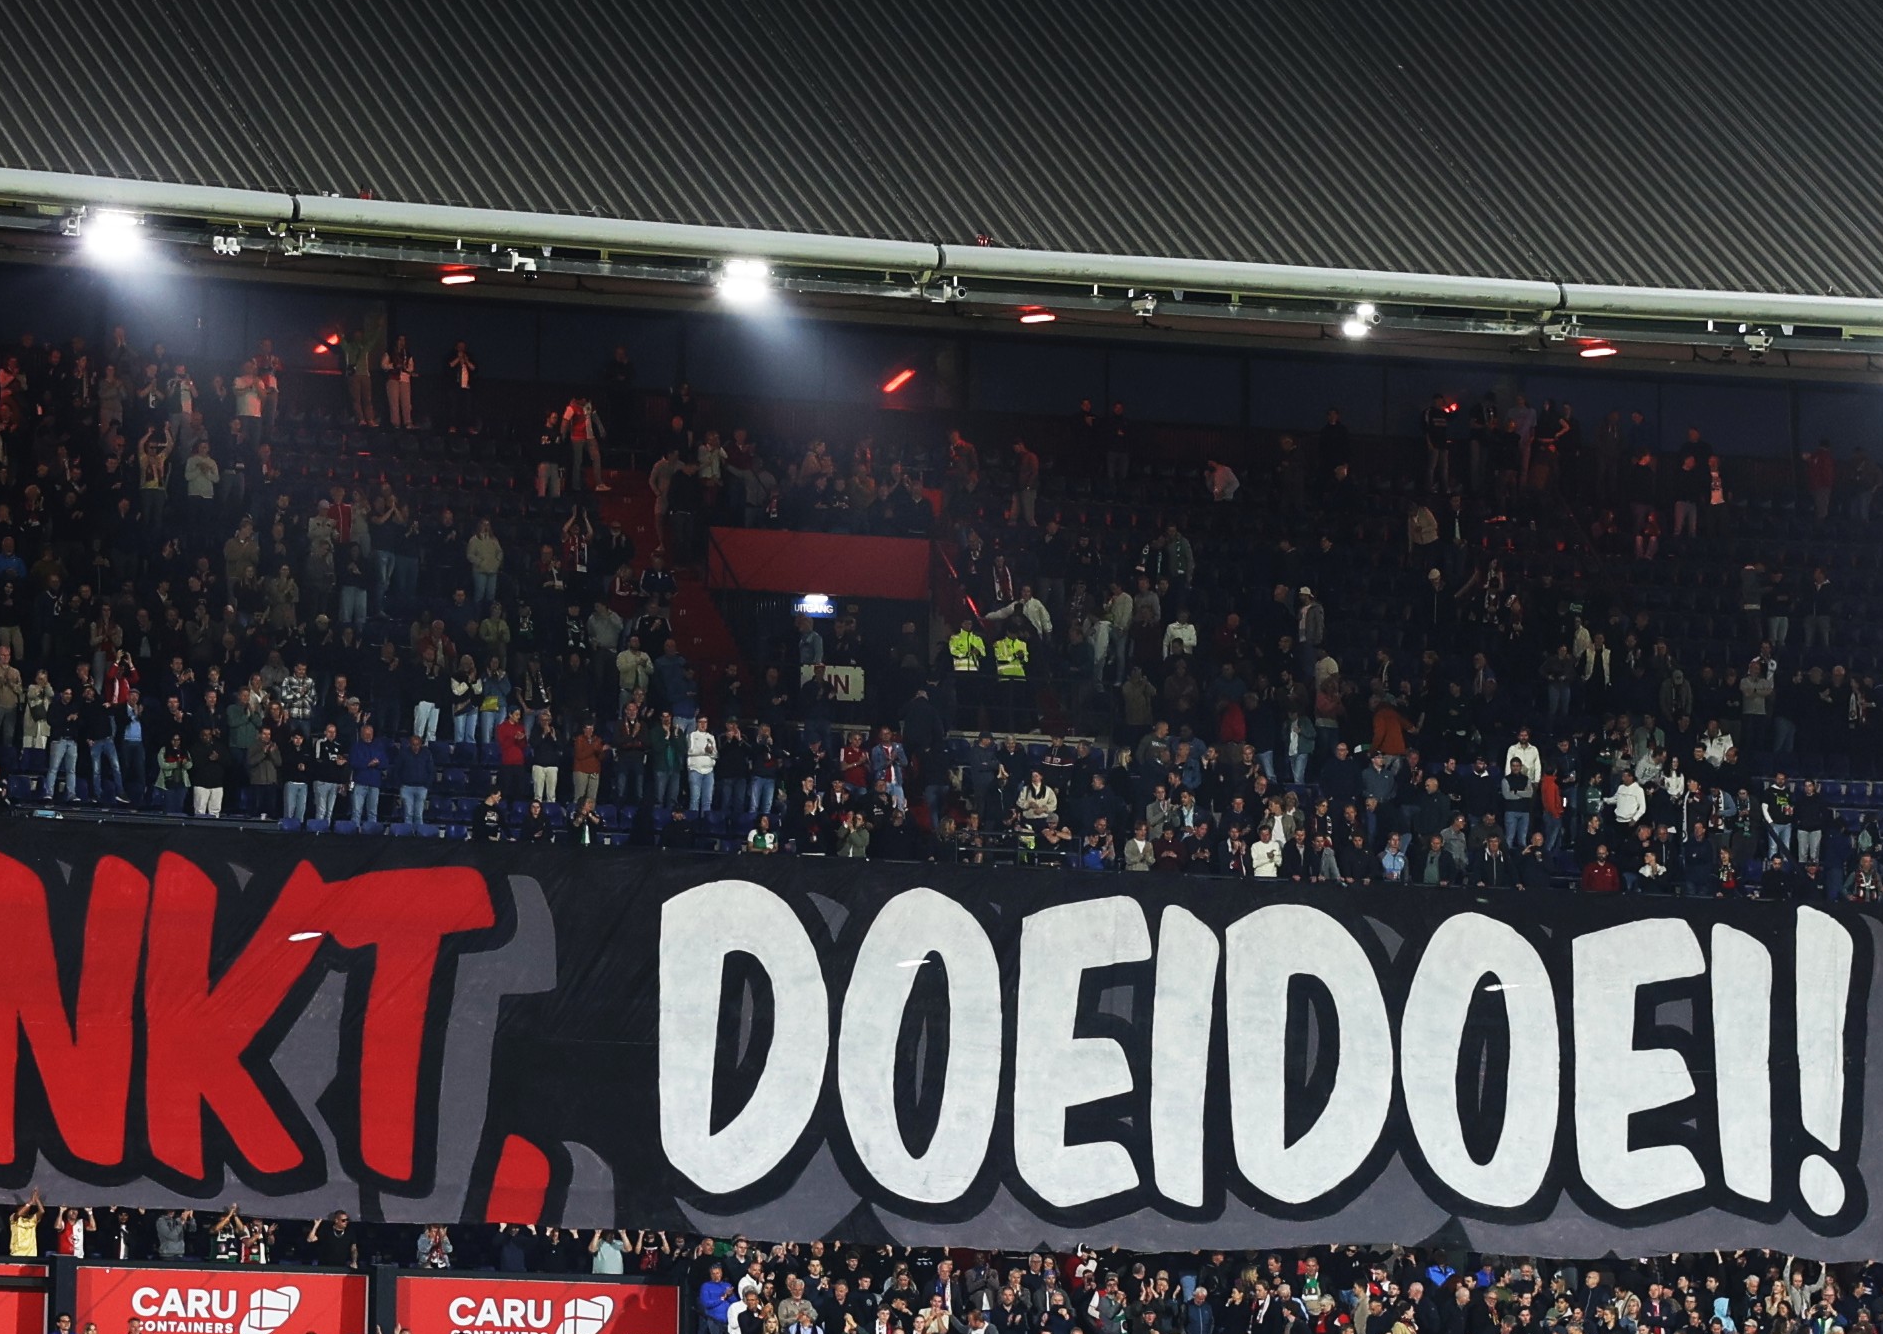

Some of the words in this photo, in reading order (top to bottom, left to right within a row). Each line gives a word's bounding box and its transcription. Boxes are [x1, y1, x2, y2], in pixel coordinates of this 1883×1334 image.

[794, 603, 834, 614] UITGANG
[659, 880, 1854, 1217] DOEIDOEI!
[131, 1286, 238, 1318] CARU
[448, 1296, 552, 1329] CARU
